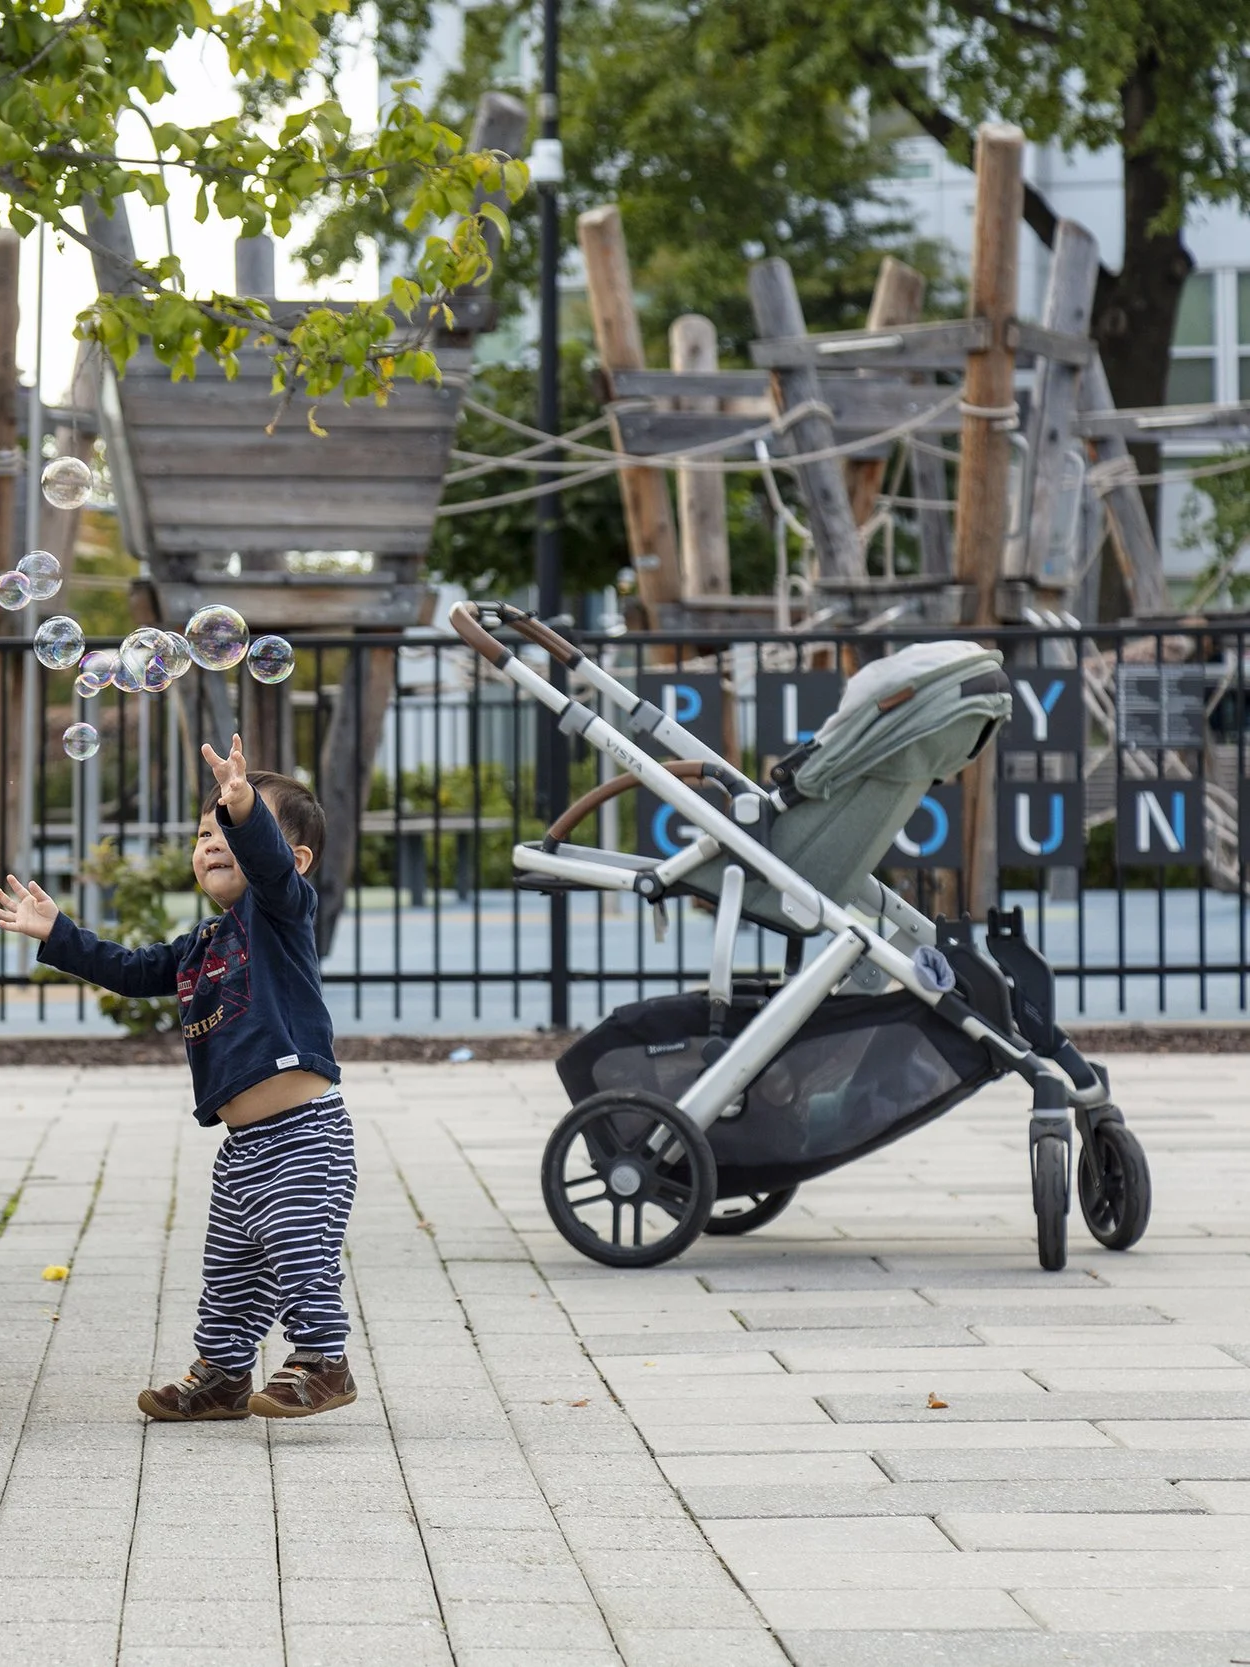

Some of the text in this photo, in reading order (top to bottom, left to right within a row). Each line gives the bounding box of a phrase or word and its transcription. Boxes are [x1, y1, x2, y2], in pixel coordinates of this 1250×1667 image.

[662, 680, 1067, 743] PLY
[607, 737, 643, 772] VISTA
[652, 790, 1186, 858] GOUN
[184, 1004, 225, 1038] CHIEF
